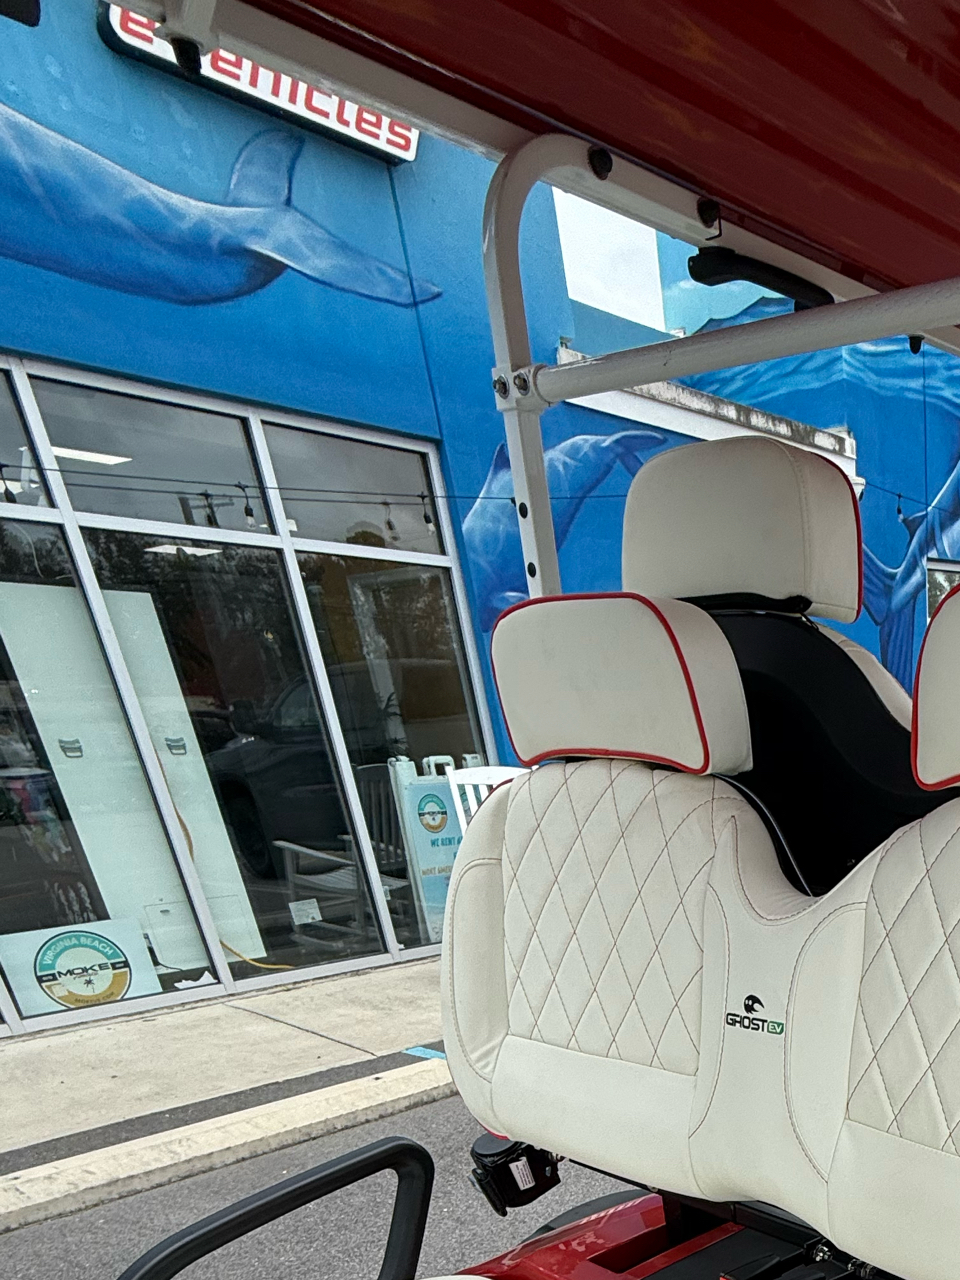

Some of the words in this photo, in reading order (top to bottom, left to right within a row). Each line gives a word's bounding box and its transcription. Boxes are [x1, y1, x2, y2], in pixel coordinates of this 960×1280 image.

[42, 936, 79, 965] VIRGINIA
[79, 935, 115, 956] BEACH
[56, 961, 111, 979] MOKE
[725, 1012, 768, 1032] GHOST
[768, 1022, 784, 1034] EV
